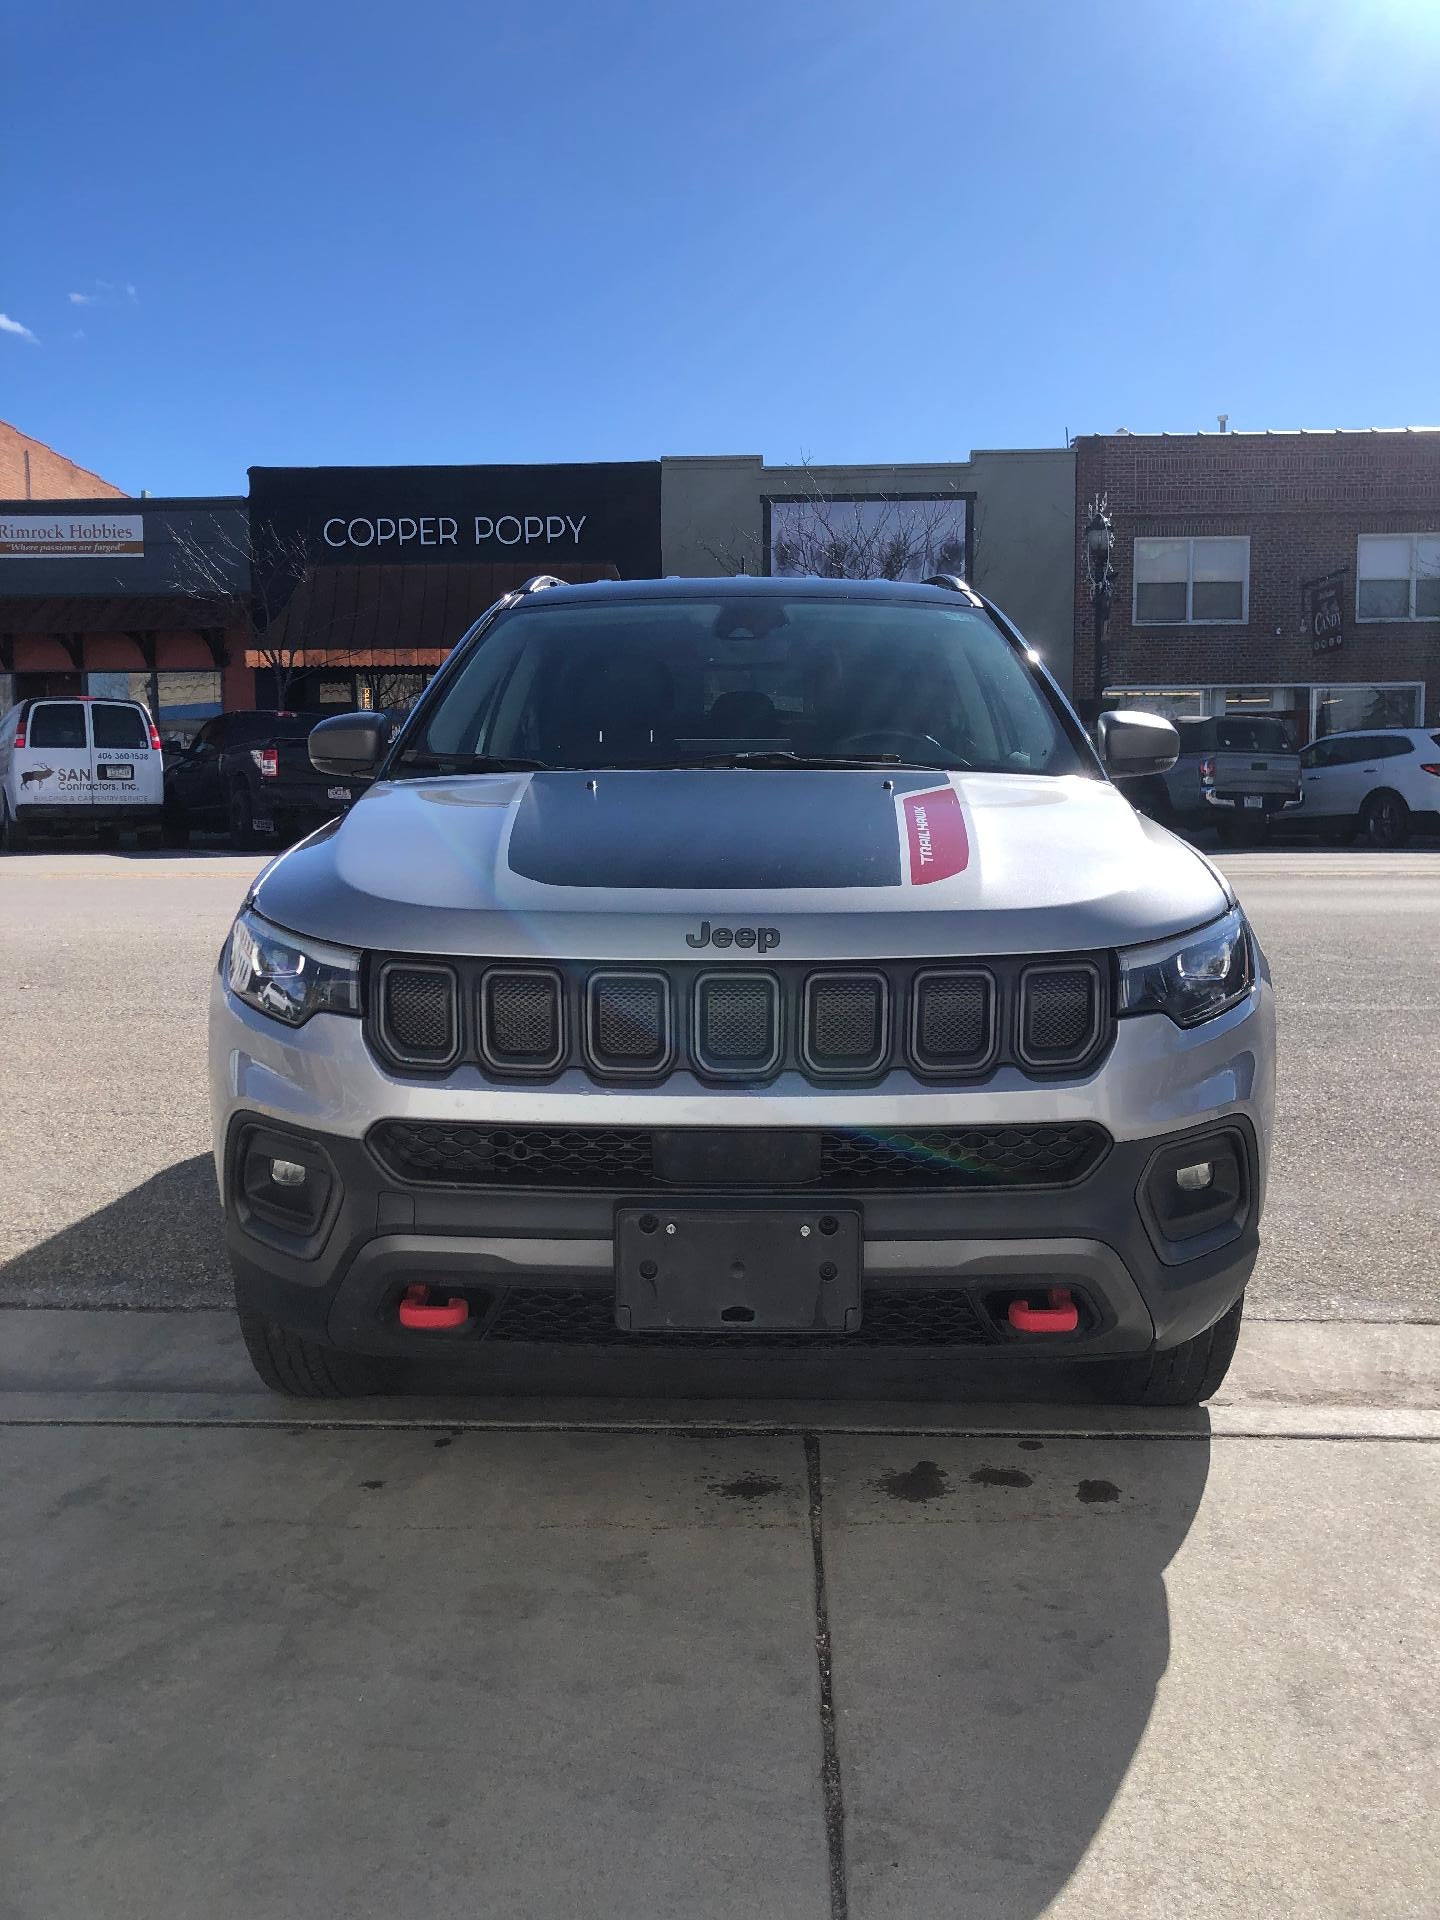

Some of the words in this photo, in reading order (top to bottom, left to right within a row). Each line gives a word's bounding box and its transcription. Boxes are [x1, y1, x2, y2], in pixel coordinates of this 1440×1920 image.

[0, 524, 65, 539] Rimrock
[69, 523, 133, 539] Hobbies
[323, 517, 458, 547] COPPER
[474, 515, 587, 545] POPPY
[39, 543, 77, 553] passions
[57, 768, 91, 782] SAN
[121, 782, 140, 791] Inc.
[913, 805, 934, 866] TRAILHAWK
[685, 920, 781, 953] Jeep
